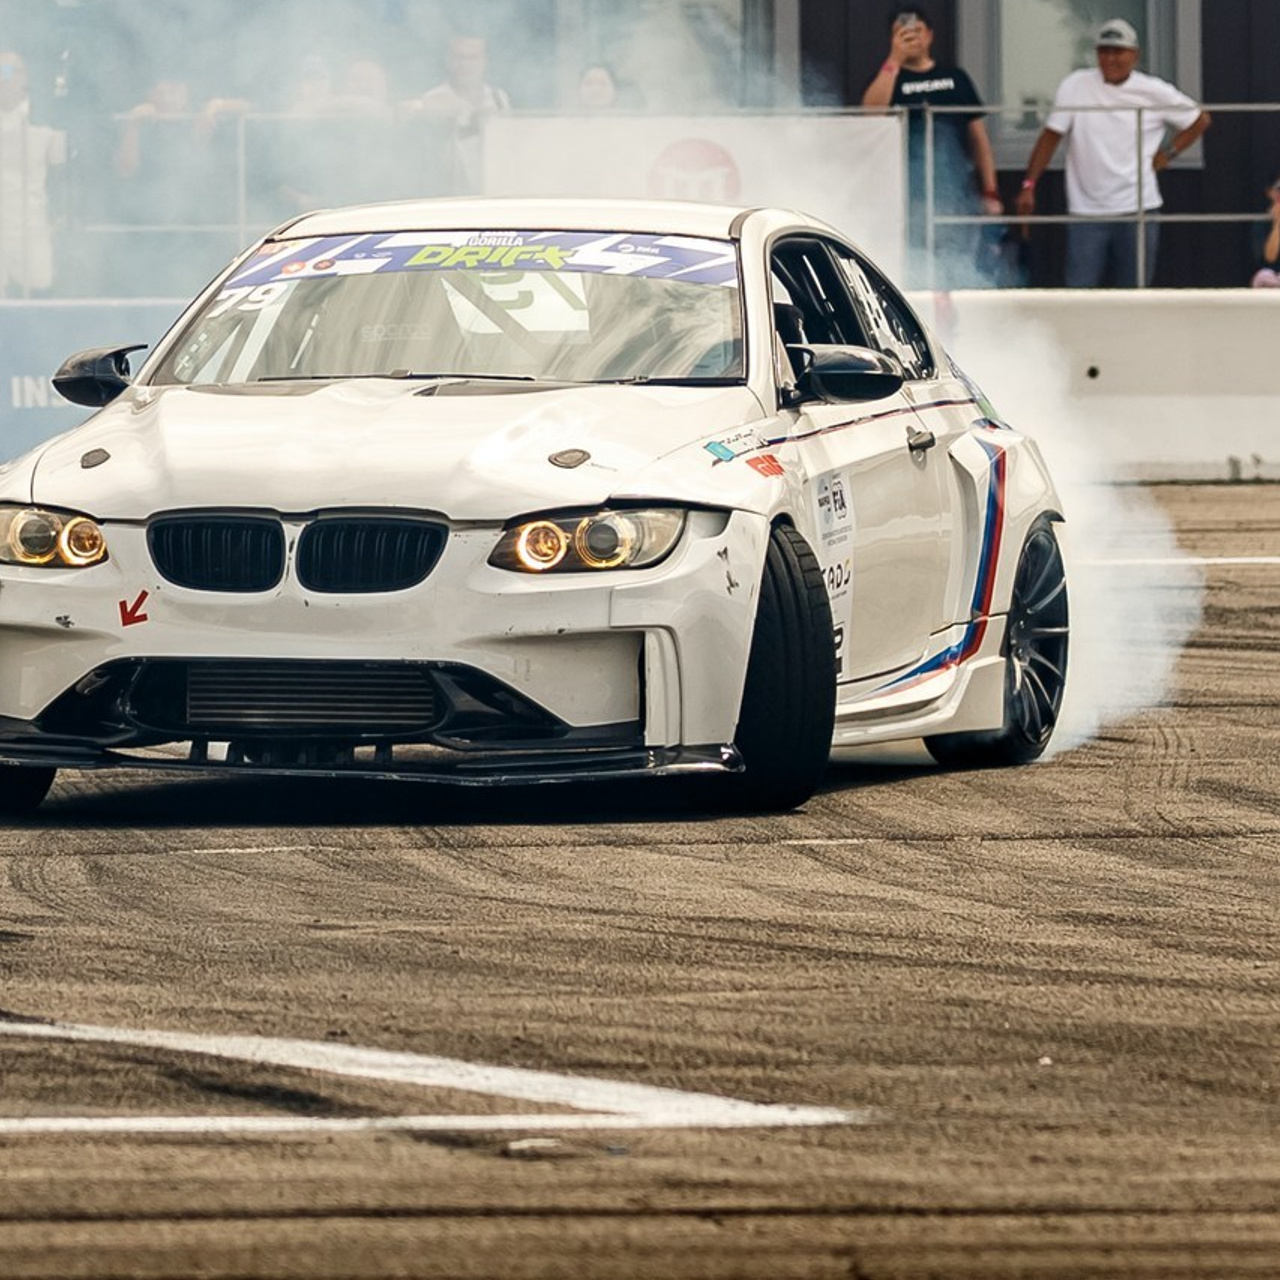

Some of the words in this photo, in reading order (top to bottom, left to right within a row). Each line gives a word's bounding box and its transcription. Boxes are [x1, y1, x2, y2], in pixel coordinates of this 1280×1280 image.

[467, 235, 524, 246] GORILLA
[404, 245, 574, 269] DRIFT
[206, 282, 289, 318] 79
